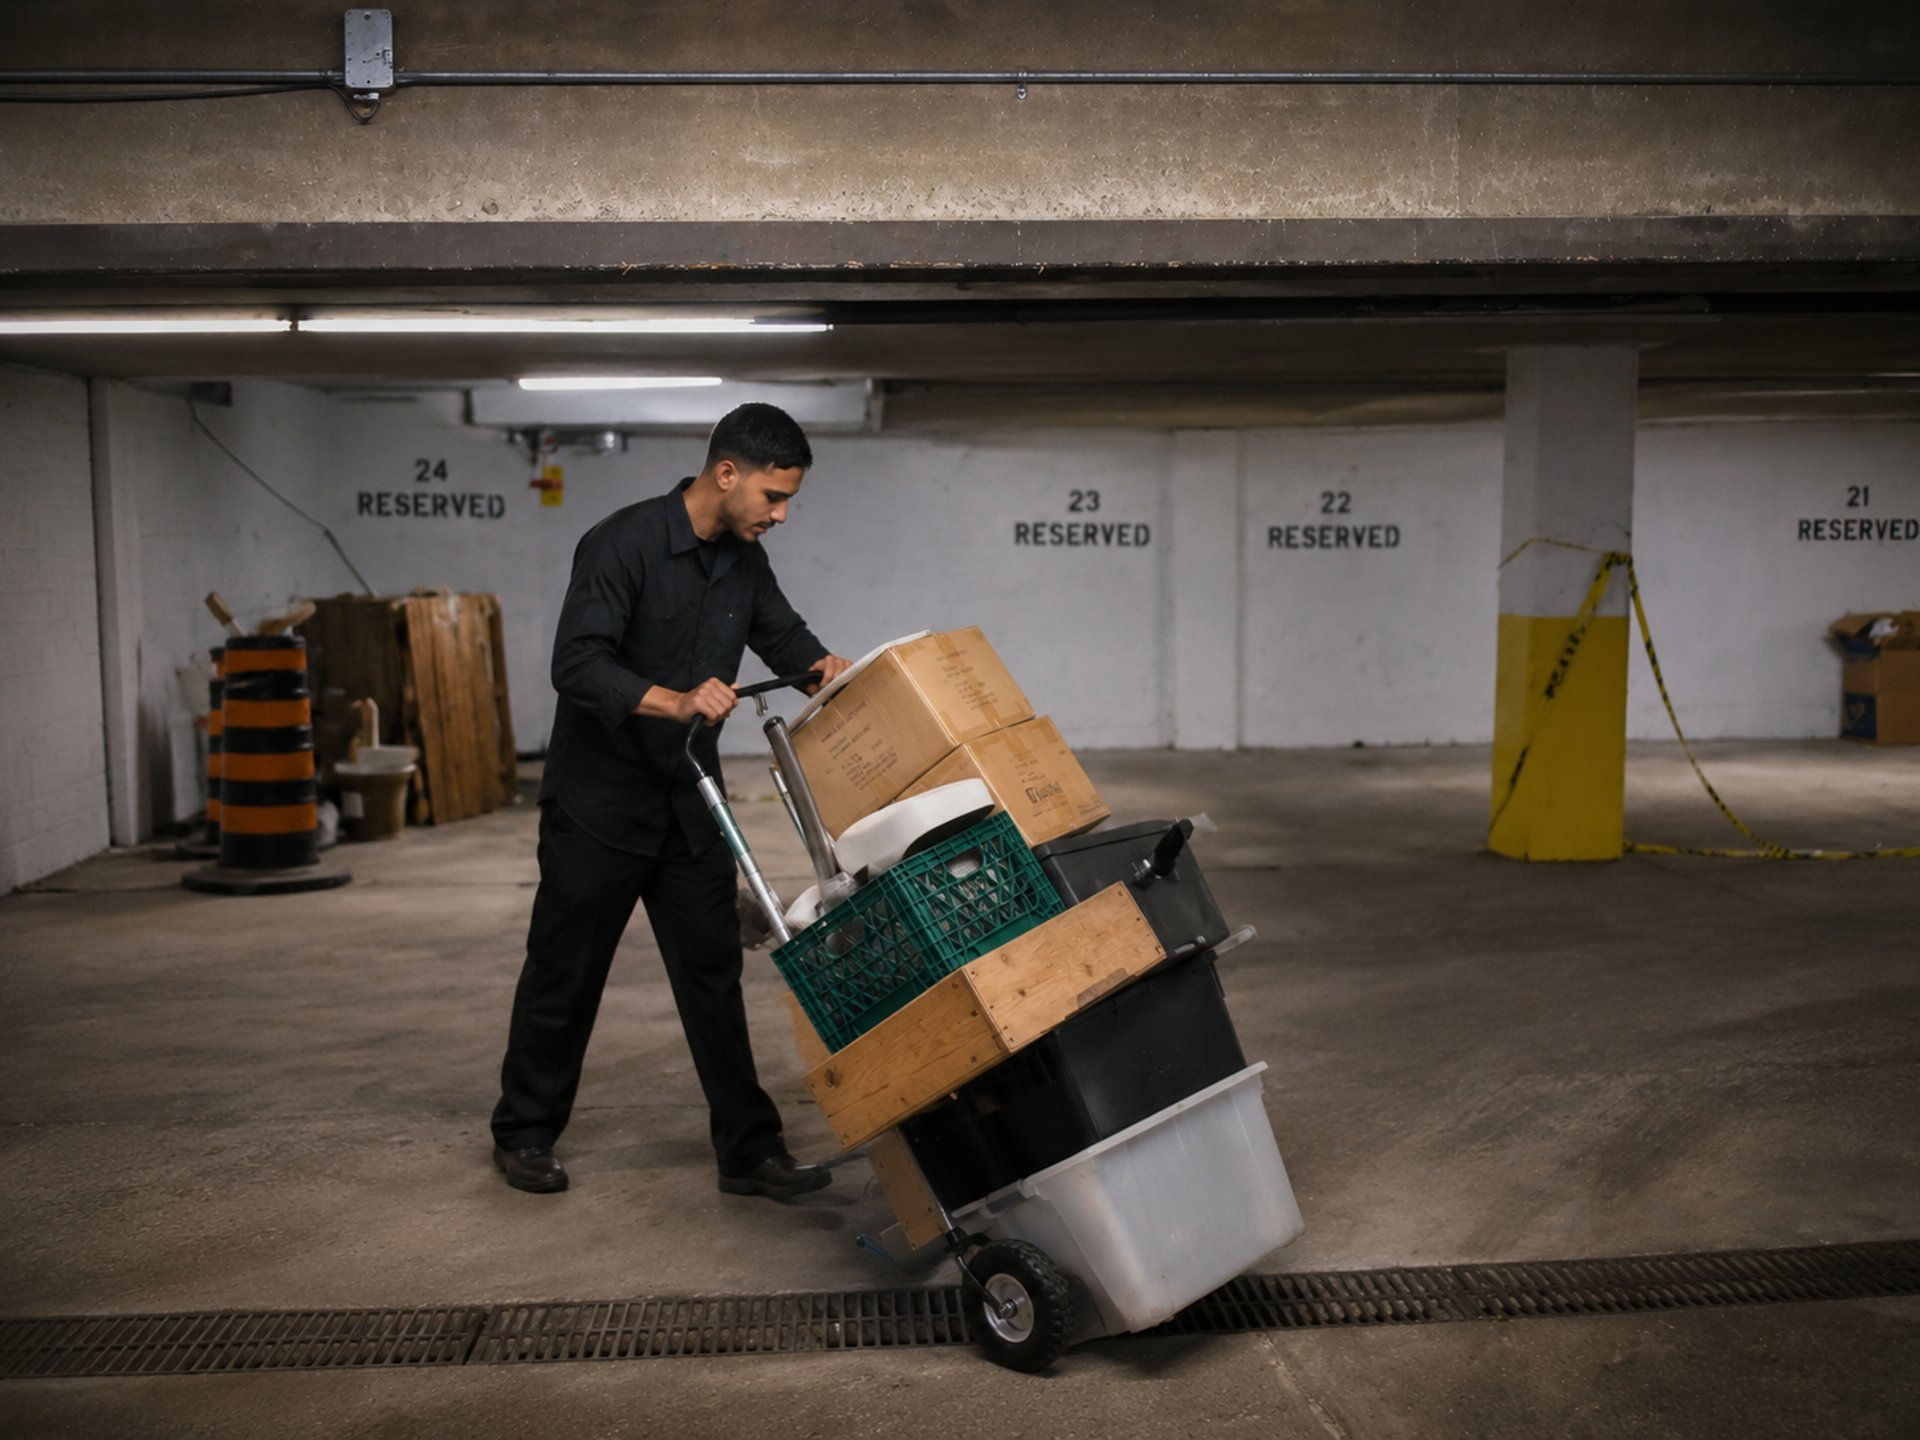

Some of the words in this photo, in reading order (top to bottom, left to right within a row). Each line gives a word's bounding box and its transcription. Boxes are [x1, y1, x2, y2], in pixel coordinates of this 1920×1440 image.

[415, 458, 449, 483] 24
[357, 491, 505, 520] RESERVED
[1068, 489, 1101, 513] 23
[1320, 490, 1352, 515] 22
[1847, 485, 1870, 508] 21
[1014, 522, 1151, 547] RESERVED
[1268, 525, 1400, 550] RESERVED
[1798, 518, 1920, 542] RESERVED
